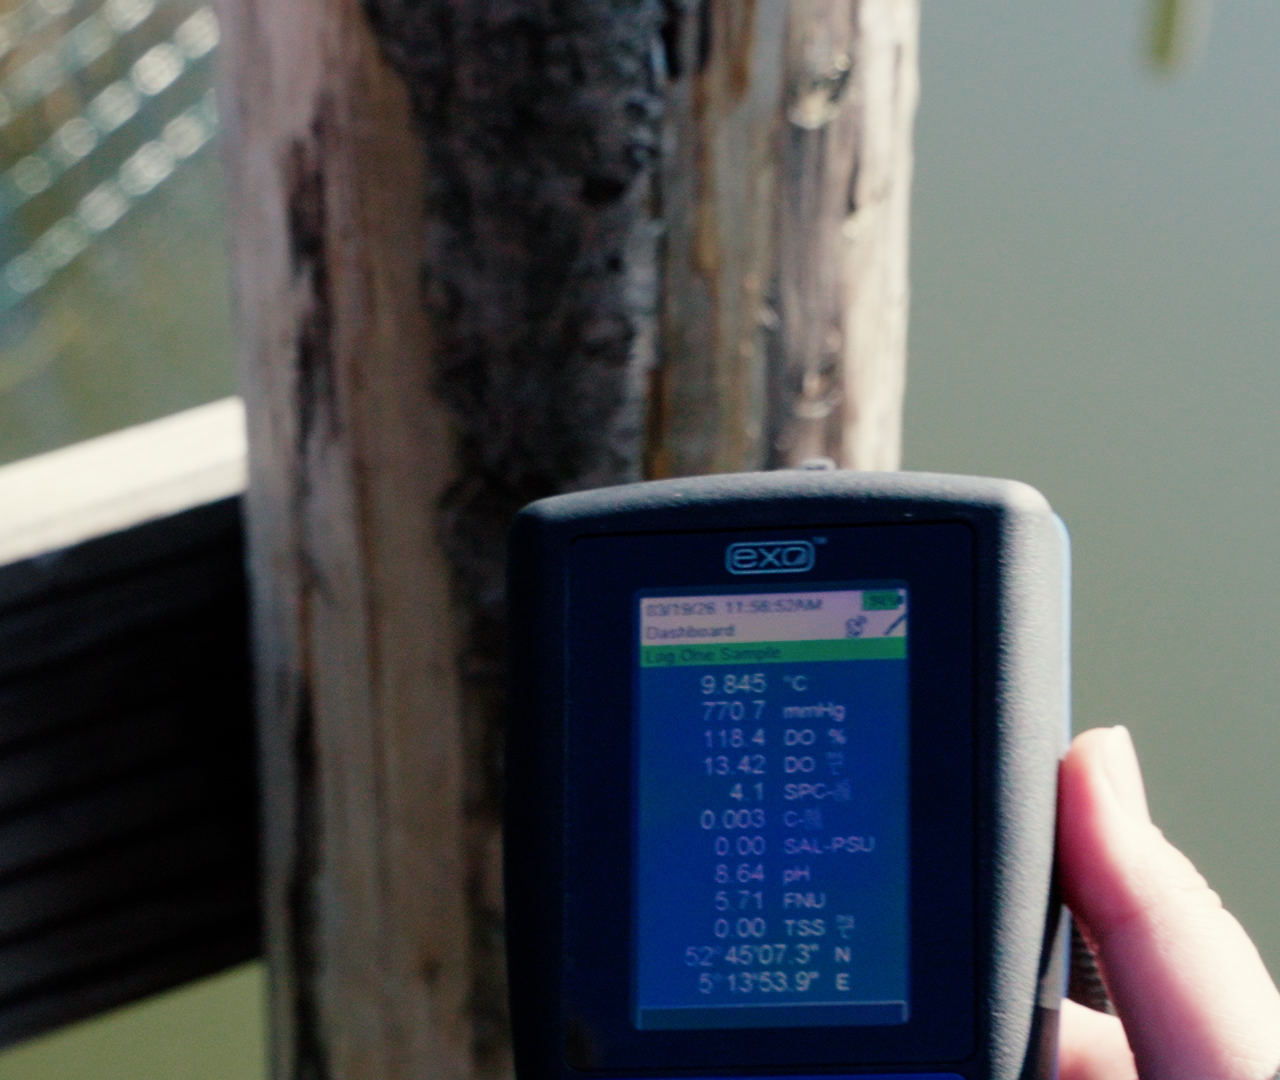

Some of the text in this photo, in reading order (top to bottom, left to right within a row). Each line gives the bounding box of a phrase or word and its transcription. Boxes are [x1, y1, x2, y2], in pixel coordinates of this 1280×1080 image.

[646, 625, 736, 640] Dashboard
[645, 646, 781, 663] Log One Sample
[700, 673, 768, 695] 9.845
[701, 700, 847, 723] 770.7 mmHg
[703, 728, 848, 748] 118.4 DO %
[703, 754, 767, 776] 13.42
[783, 756, 816, 774] DO
[729, 783, 765, 801] 4.1
[700, 809, 766, 829] 0.003
[715, 836, 876, 856] 0.00 SAL-PSU
[715, 863, 811, 885] 8.64 pH
[715, 891, 827, 911] 5.71 FNU
[715, 917, 767, 938] 0.00
[783, 919, 827, 937] TSS
[834, 946, 852, 963] N
[835, 973, 851, 991] E
